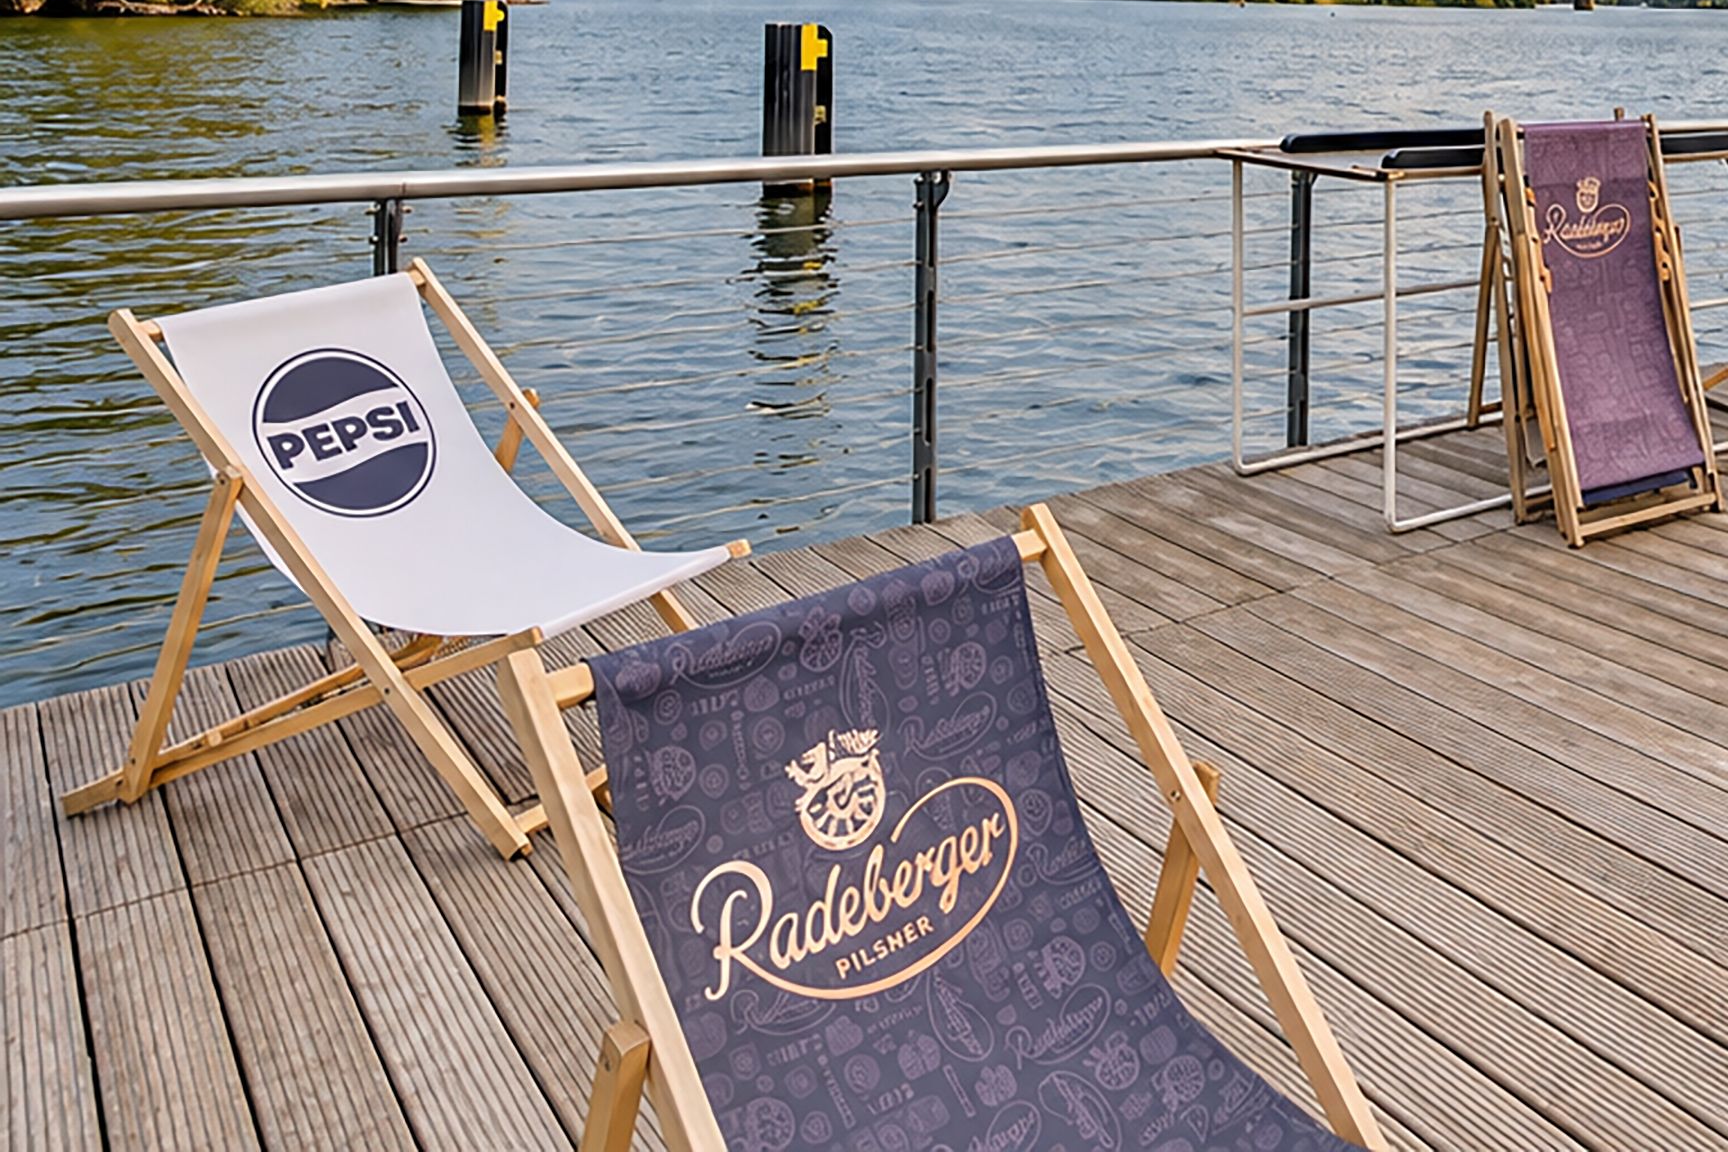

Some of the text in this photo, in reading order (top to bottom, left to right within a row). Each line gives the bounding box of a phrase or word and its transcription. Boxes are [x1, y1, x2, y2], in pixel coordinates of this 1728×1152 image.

[266, 400, 421, 471] PEPSI
[690, 811, 1006, 1000] Radeberger
[834, 914, 935, 980] PILSNER
